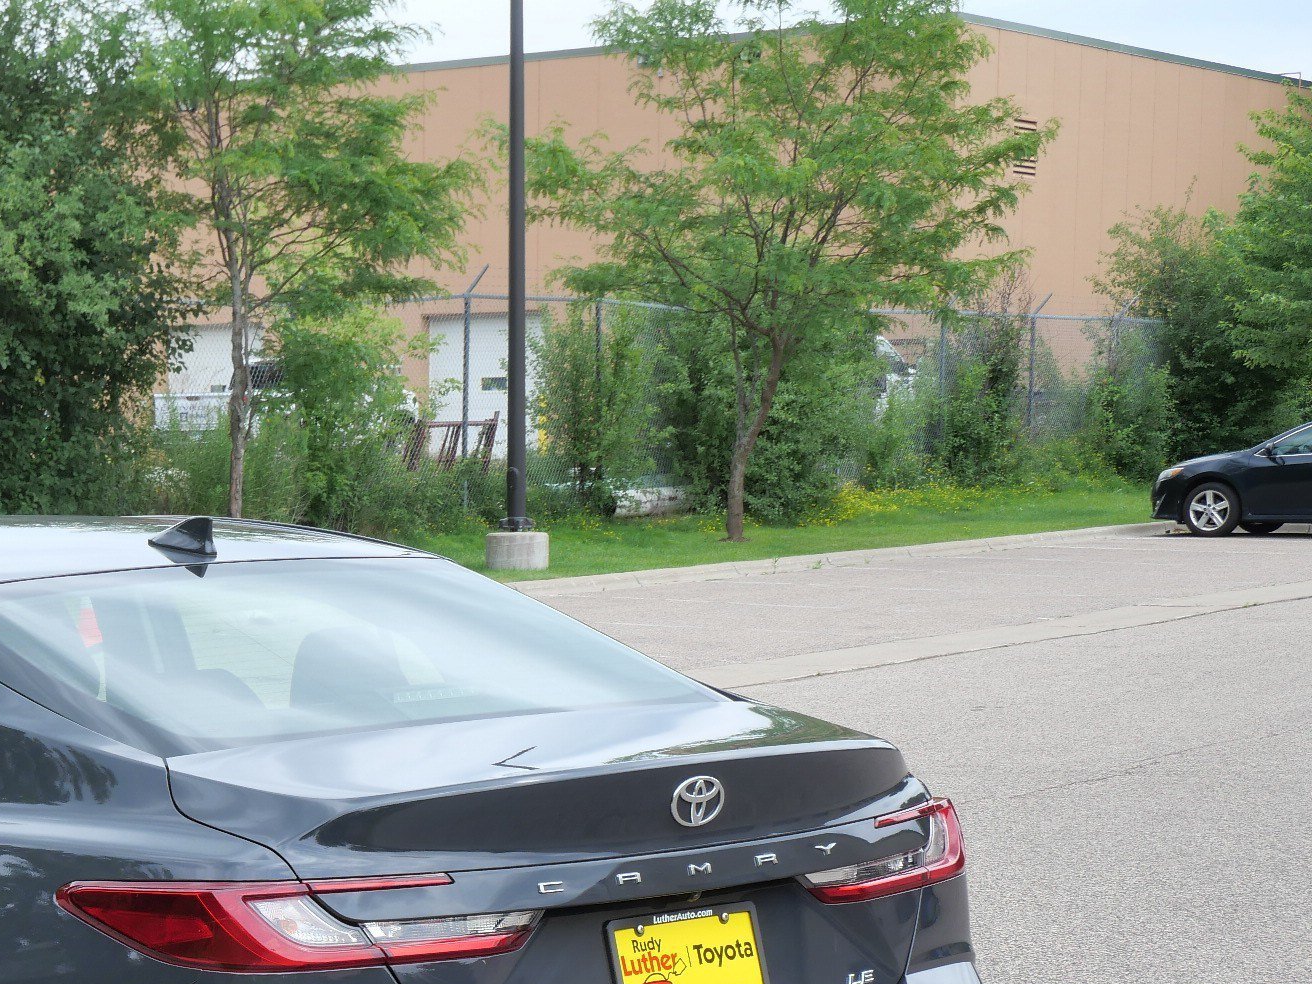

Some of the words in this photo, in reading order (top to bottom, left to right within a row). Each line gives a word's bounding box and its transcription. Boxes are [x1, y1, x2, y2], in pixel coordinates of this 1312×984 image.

[538, 841, 837, 893] CAMRY
[653, 909, 713, 924] LutherAuto.com
[631, 937, 661, 953] Rudy
[693, 939, 754, 968] Toyota
[621, 951, 678, 977] Luther
